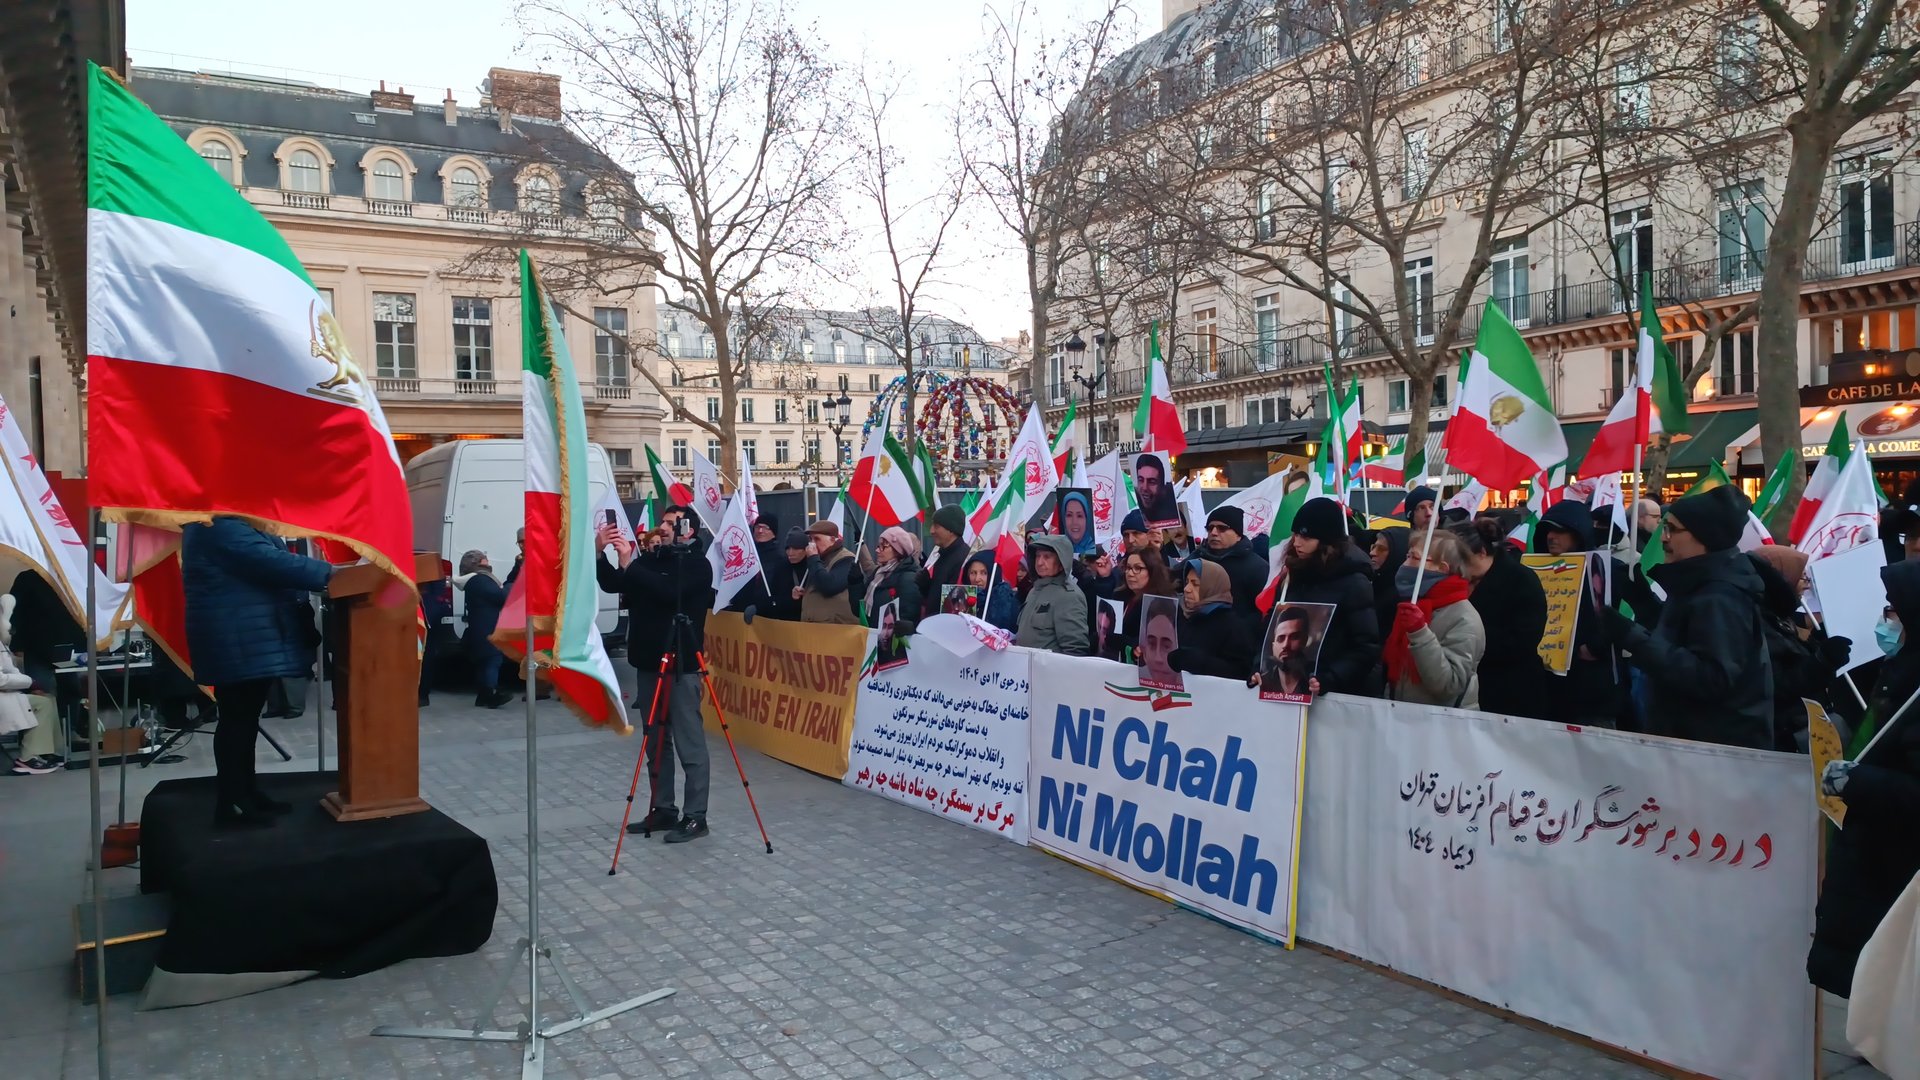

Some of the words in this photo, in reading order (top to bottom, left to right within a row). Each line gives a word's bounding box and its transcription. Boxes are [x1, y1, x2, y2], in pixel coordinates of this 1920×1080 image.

[1827, 385, 1867, 400] CAFE
[1871, 383, 1893, 397] DE
[1898, 381, 1920, 395] LA
[1802, 445, 1828, 457] CAF
[726, 638, 740, 675] LA
[745, 642, 854, 697] DICTATURE
[980, 673, 990, 686] دی
[1000, 677, 1019, 692] رجوی
[893, 685, 923, 702] دیکتاتوری
[923, 688, 931, 701] که
[1263, 691, 1283, 700] Dariush
[1284, 693, 1304, 702] Ansari
[892, 706, 915, 724] سرنگون
[978, 699, 999, 715] ضحاک
[773, 694, 802, 732] EN
[800, 700, 841, 745] IRAN
[965, 721, 980, 734] دست
[912, 731, 928, 748] ایران
[981, 725, 988, 740] به
[927, 737, 943, 752] مردم
[978, 746, 1000, 763] انقلاب
[999, 756, 1004, 769] و
[1051, 703, 1105, 769] Ni
[1113, 716, 1258, 813] Chah
[855, 766, 874, 789] رهبر
[952, 765, 968, 778] است
[967, 769, 981, 787] بهتر
[982, 771, 991, 785] که
[875, 770, 887, 793] چه
[908, 776, 924, 798] شاه
[925, 782, 938, 809] چه
[973, 802, 986, 823] بر
[987, 801, 1014, 831] مرگ
[1037, 775, 1088, 843] Ni
[1089, 792, 1278, 915] Mollah
[1655, 825, 1678, 864] بر
[1684, 828, 1773, 871] درود
